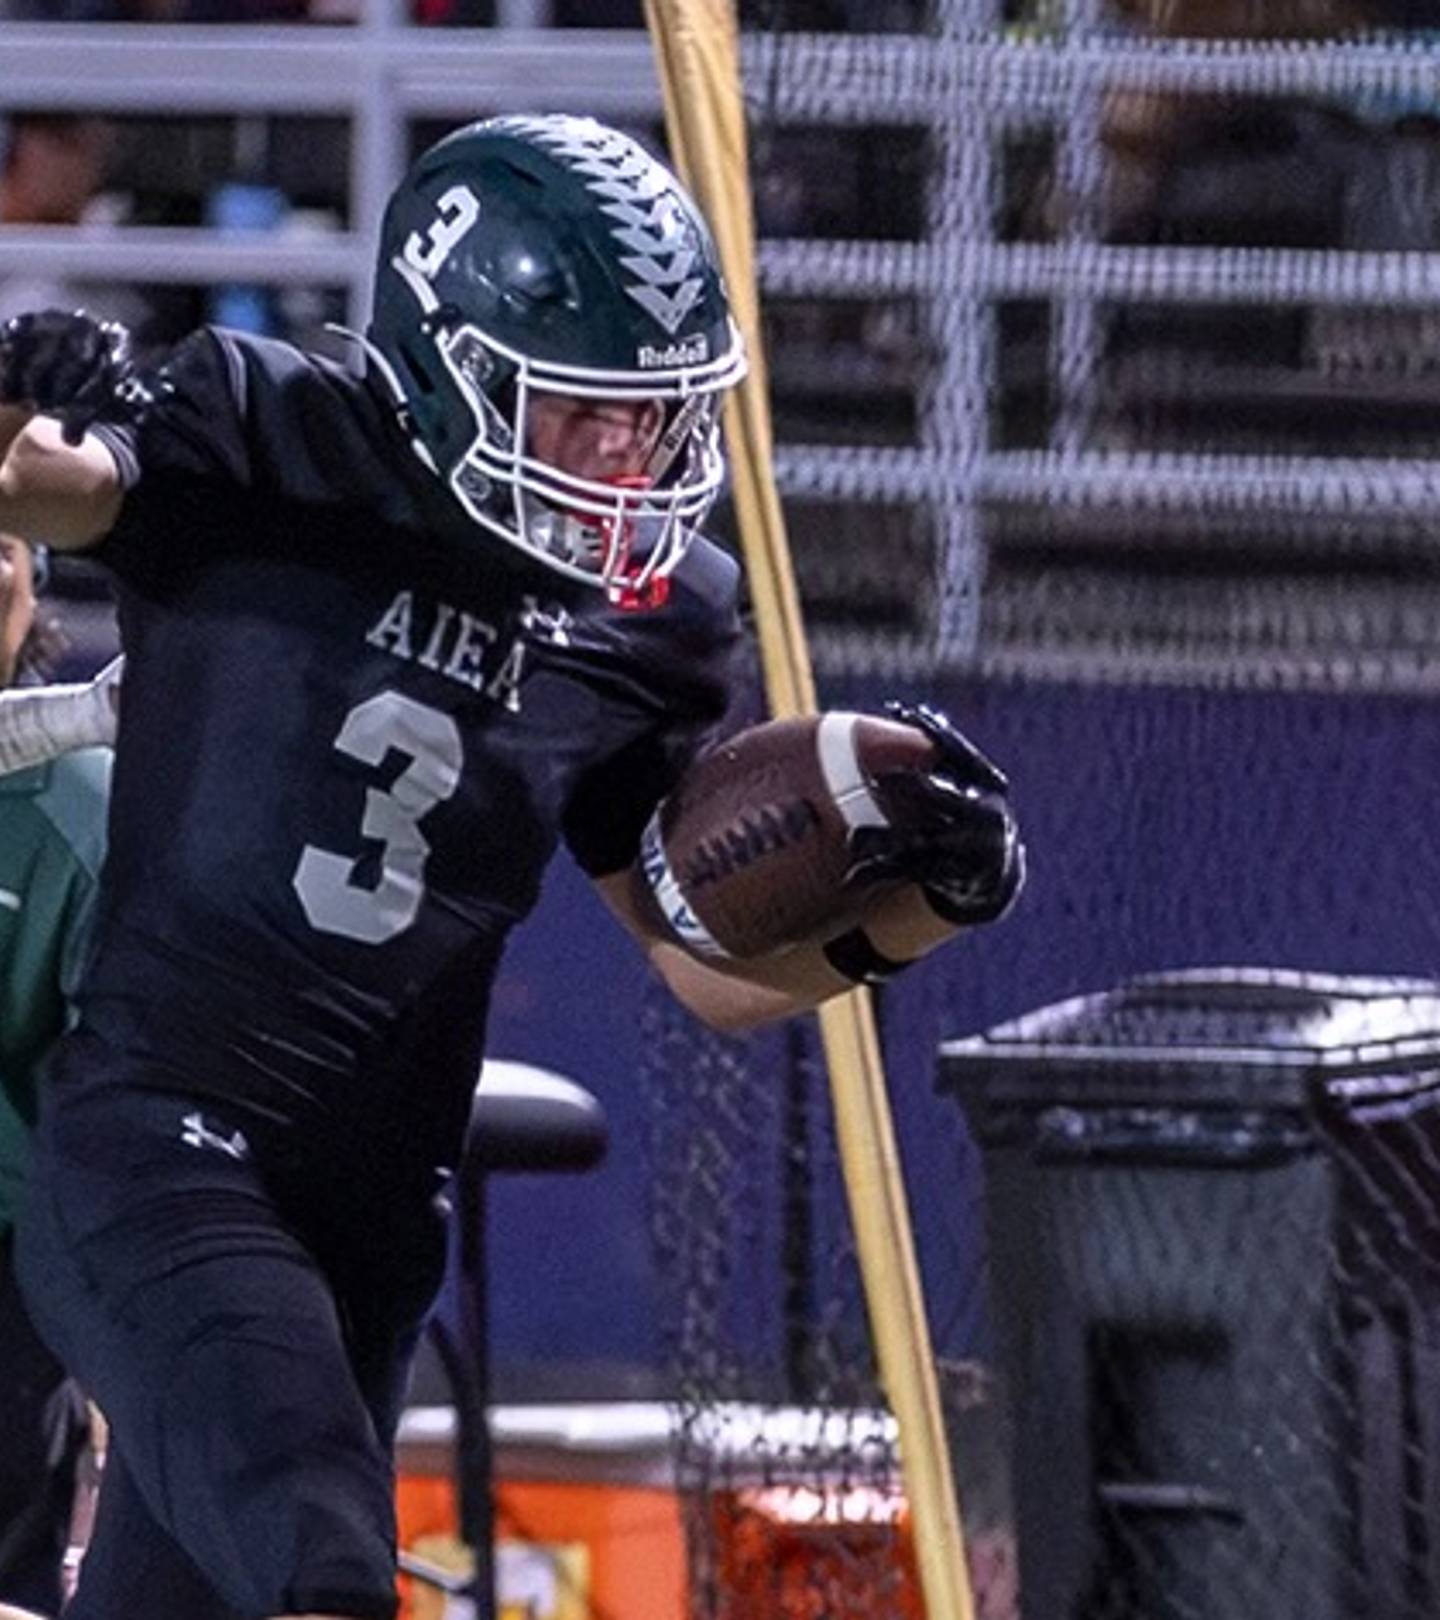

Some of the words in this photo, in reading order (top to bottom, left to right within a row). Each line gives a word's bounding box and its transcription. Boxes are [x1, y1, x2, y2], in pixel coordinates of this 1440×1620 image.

[403, 185, 481, 280] 3
[364, 590, 526, 713] AIEA
[293, 690, 463, 946] 3
